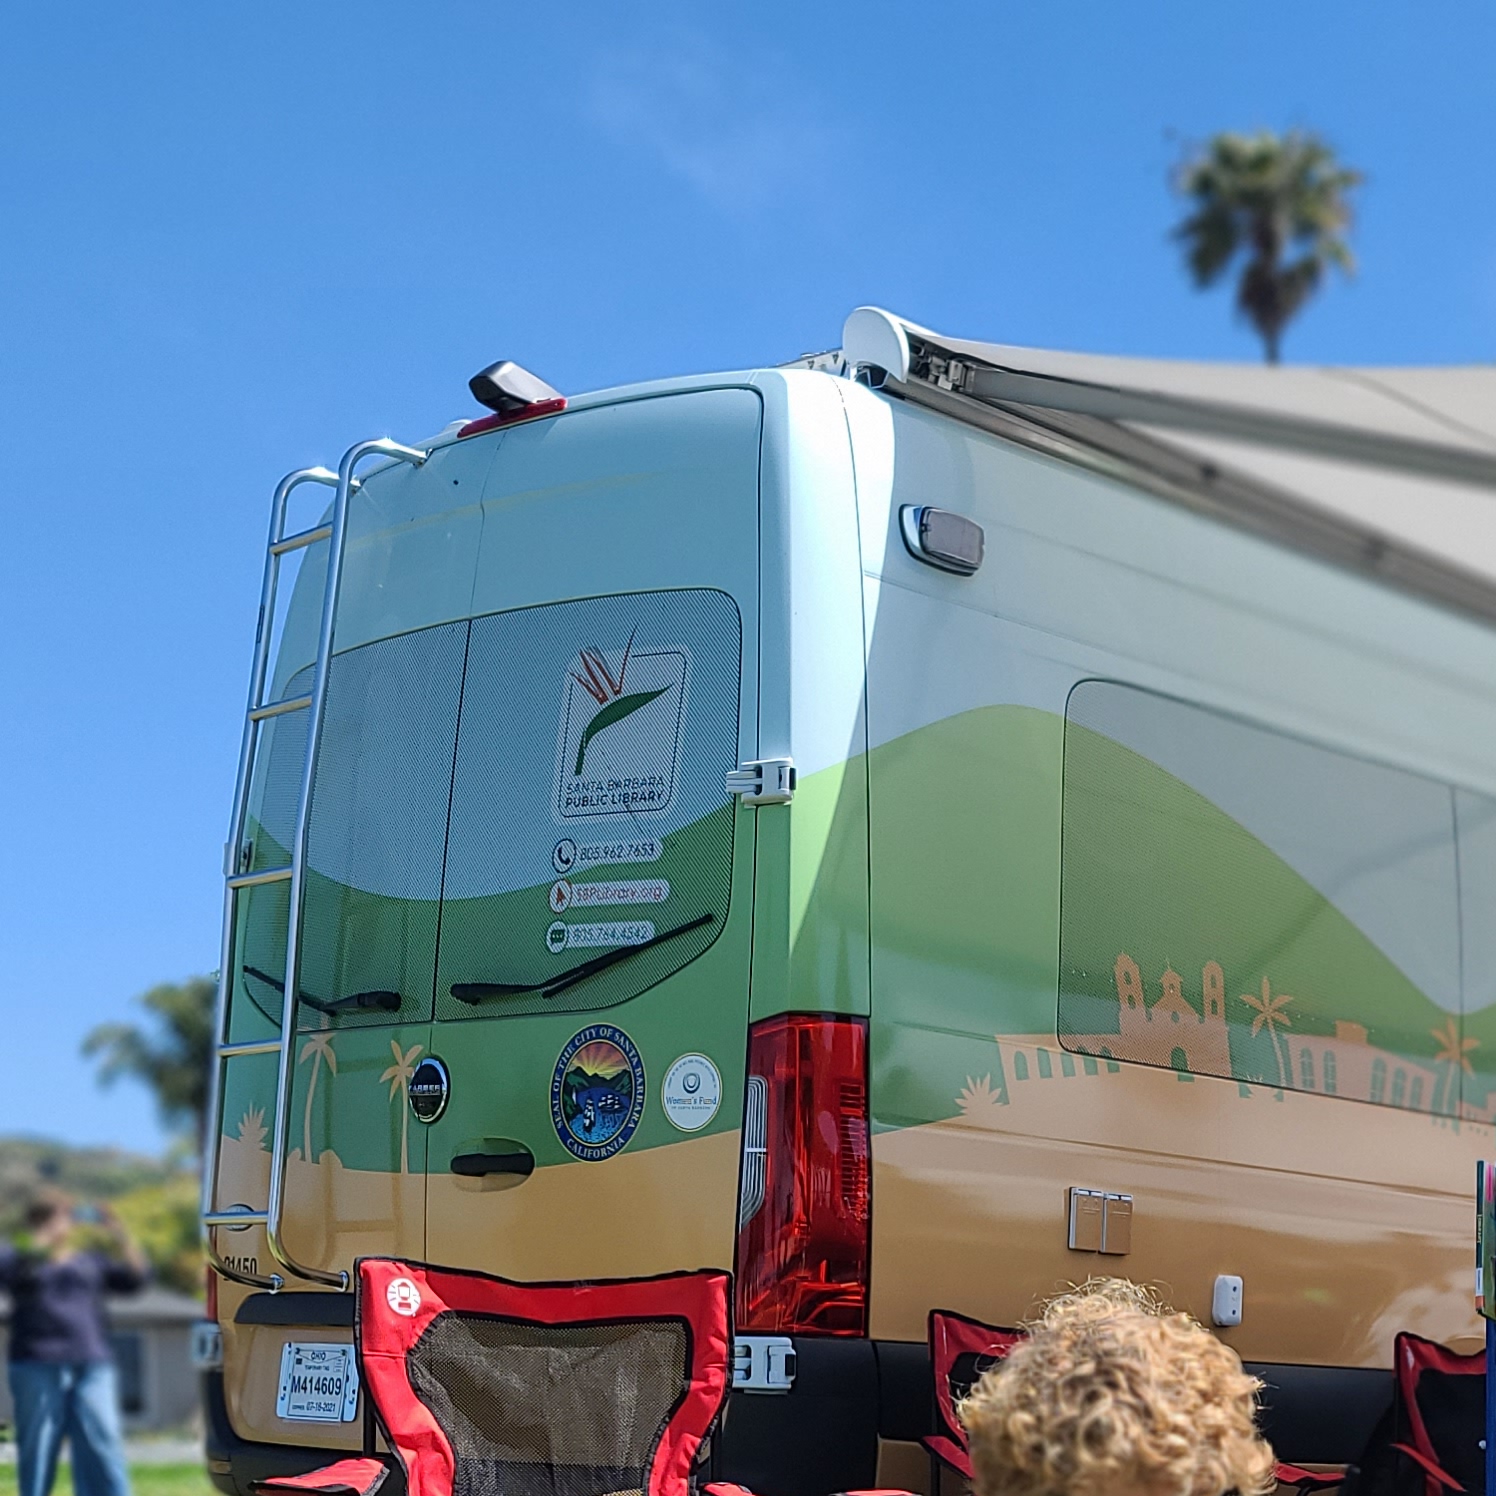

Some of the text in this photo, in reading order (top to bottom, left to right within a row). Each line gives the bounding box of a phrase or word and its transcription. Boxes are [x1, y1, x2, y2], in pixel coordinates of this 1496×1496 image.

[567, 776, 664, 794] SANTA BARBARA
[565, 790, 664, 809] PUBLIC LIBRARY
[552, 1026, 644, 1129] SEAL OF THE CITY OF SANTA BARBARA
[566, 1137, 626, 1159] CALIFORNIA
[311, 1351, 326, 1361] OHIO
[291, 1375, 342, 1395] M414609
